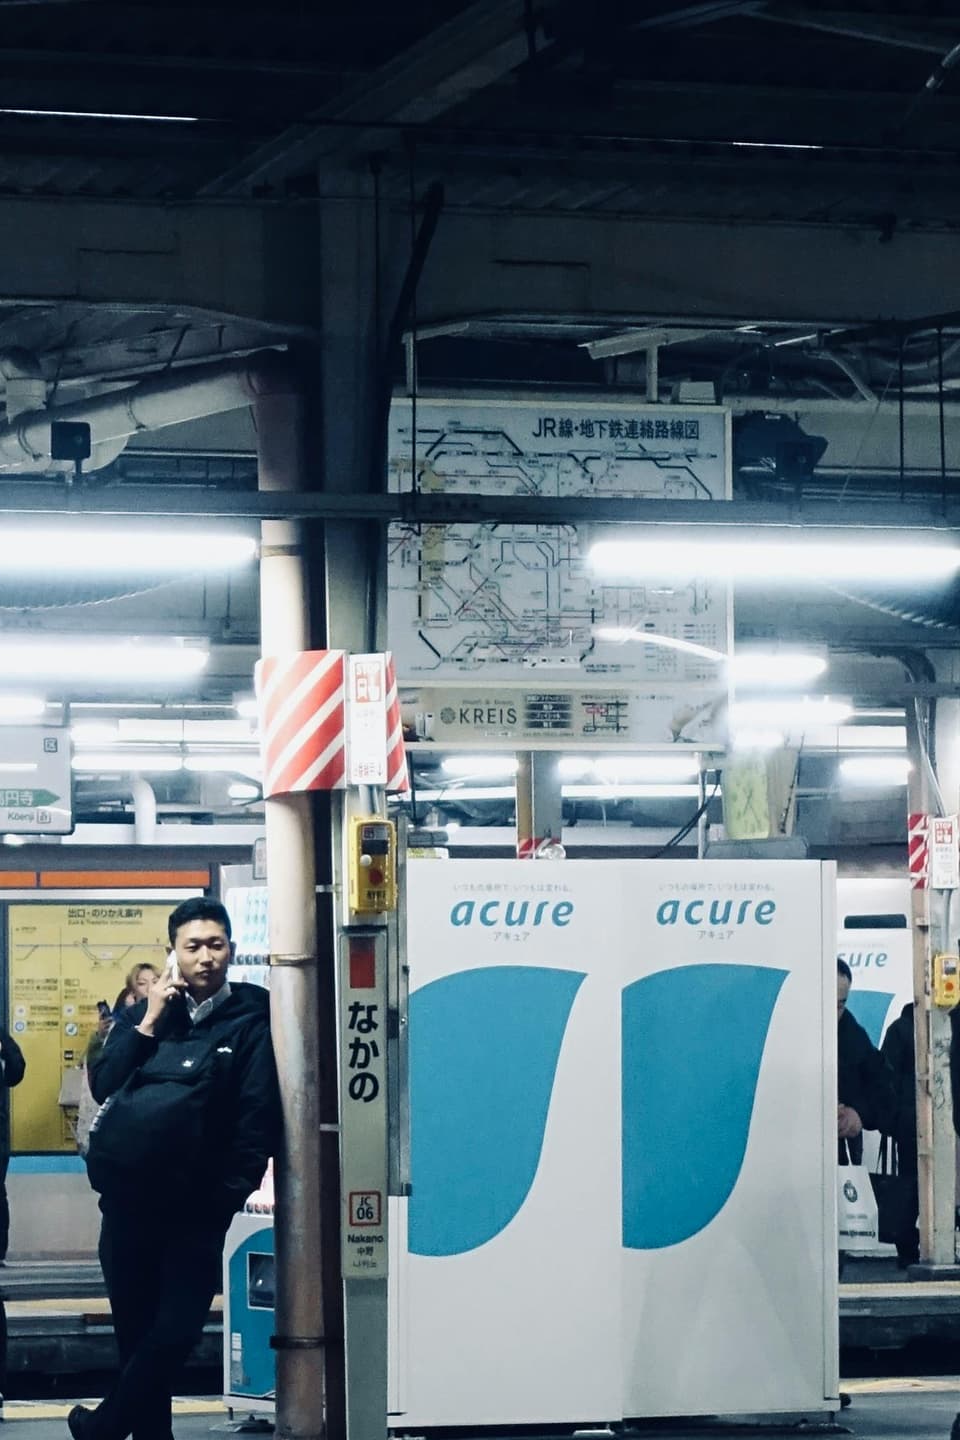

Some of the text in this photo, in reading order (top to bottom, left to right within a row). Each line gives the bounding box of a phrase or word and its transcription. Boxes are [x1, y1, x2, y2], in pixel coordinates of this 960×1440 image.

[532, 417, 700, 440] JR線・地下鉄連絡路線図
[459, 707, 517, 724] KREIS
[450, 900, 574, 927] acure
[656, 899, 776, 926] acure
[348, 1001, 380, 1103] なかの
[356, 1207, 374, 1220] 06
[347, 1234, 384, 1243] Nakano
